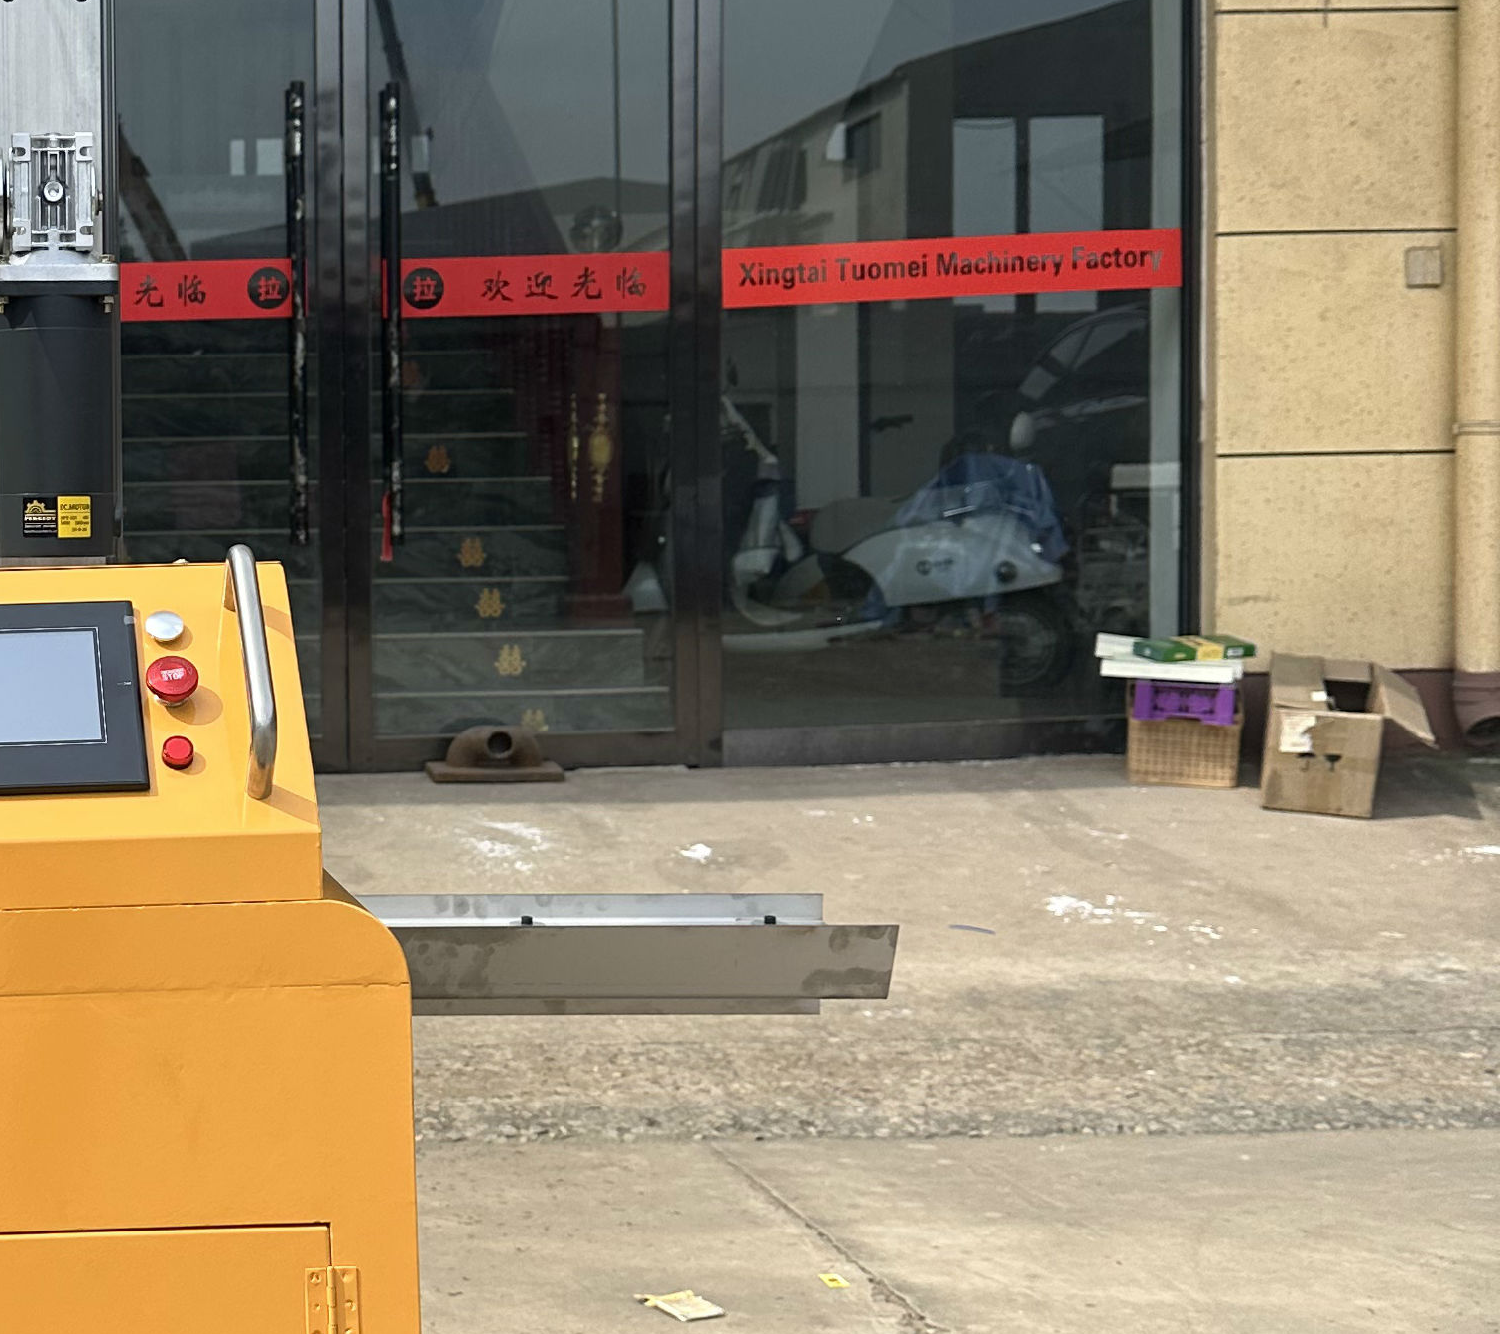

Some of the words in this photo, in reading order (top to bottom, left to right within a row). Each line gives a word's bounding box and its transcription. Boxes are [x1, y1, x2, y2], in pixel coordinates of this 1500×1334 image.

[738, 259, 828, 290] Xingtai
[835, 254, 928, 282] Tuomei
[936, 249, 1065, 277] Machinery
[1071, 245, 1164, 273] Factory
[257, 275, 283, 302] 拉
[412, 275, 438, 301] 拉
[480, 266, 648, 303] 欢迎光临
